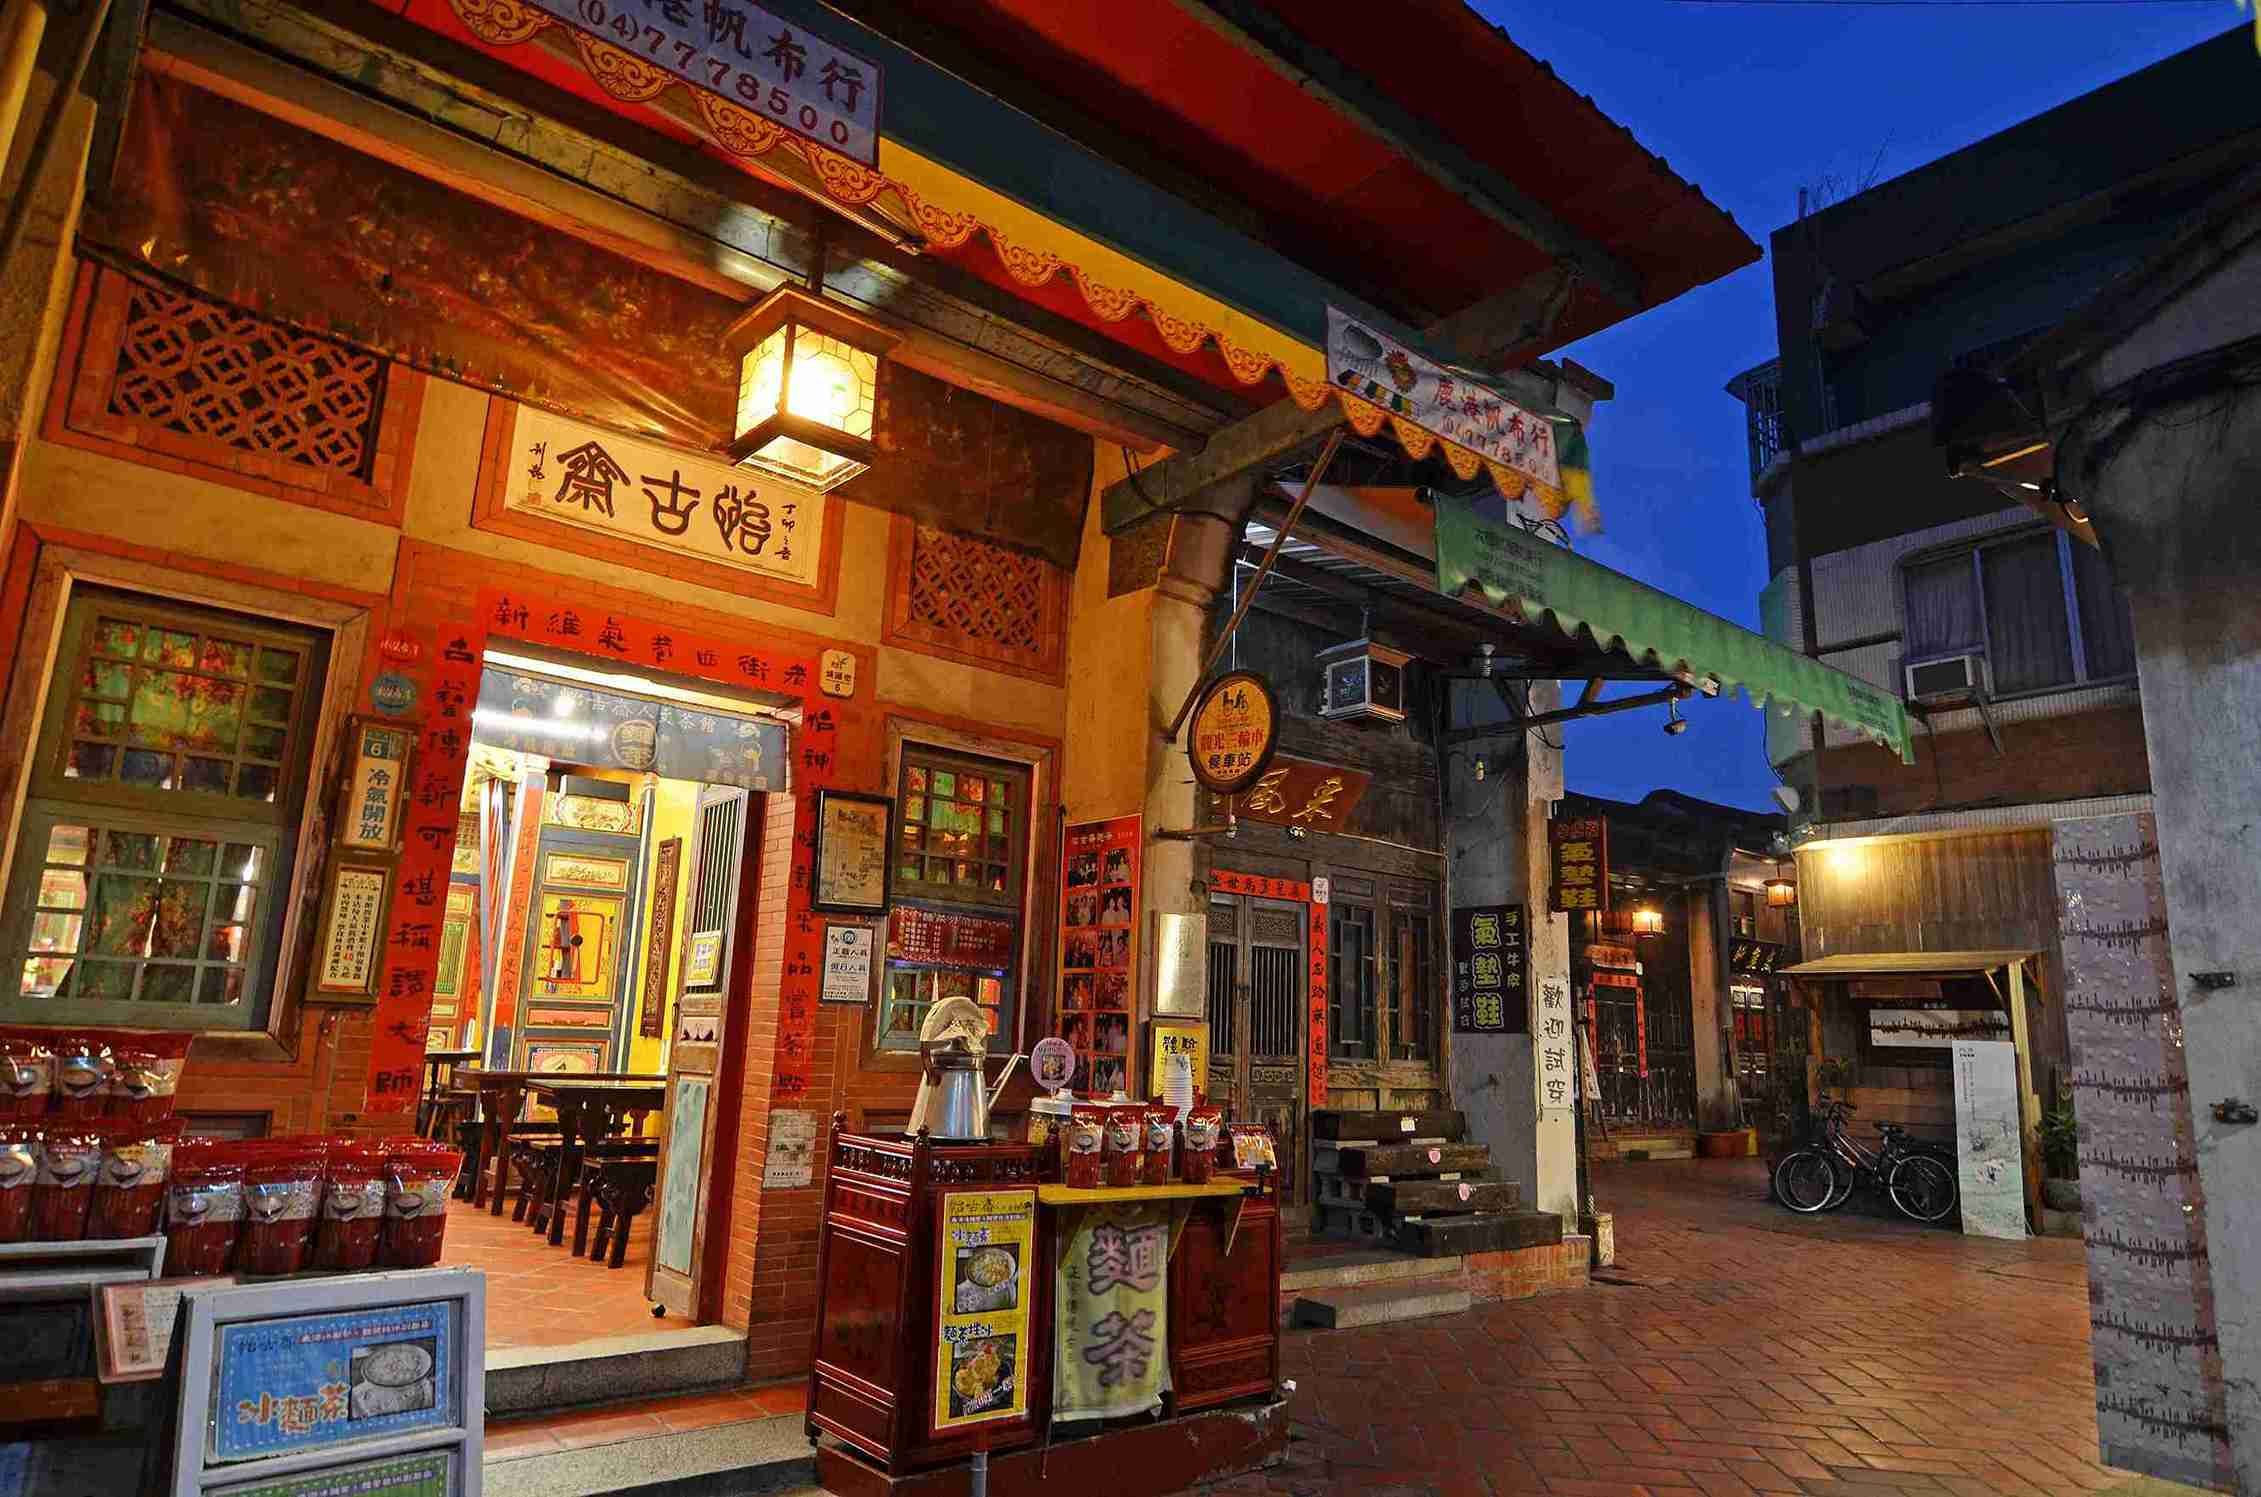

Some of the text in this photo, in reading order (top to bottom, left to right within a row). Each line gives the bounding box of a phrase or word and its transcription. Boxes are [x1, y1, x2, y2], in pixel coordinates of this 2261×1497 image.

[370, 743, 382, 757] 6
[359, 767, 391, 841] 冷氣開放
[1472, 914, 1503, 1029] 氣墊鞋
